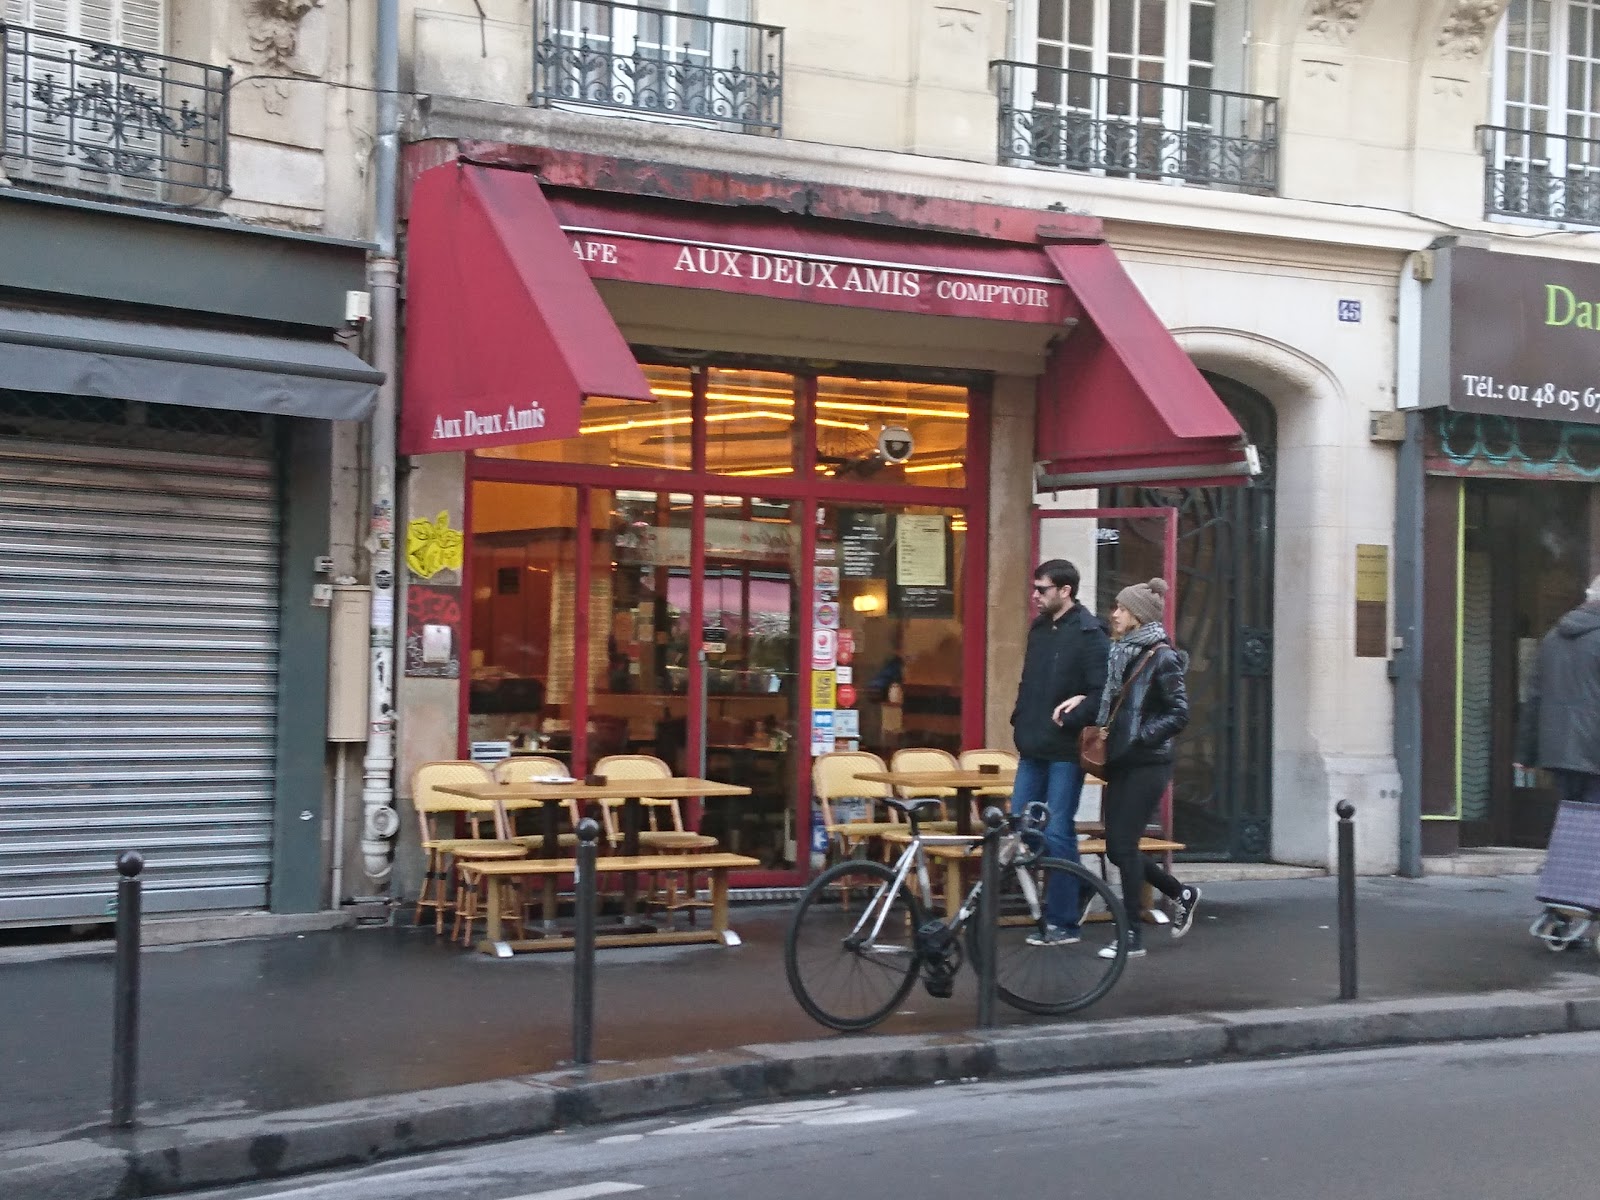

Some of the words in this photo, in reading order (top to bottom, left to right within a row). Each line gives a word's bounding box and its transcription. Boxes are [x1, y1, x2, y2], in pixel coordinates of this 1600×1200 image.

[673, 245, 743, 278] AUX
[749, 254, 838, 289] DEUX
[842, 266, 920, 298] AMIS
[936, 280, 1049, 308] COMPTOIR
[1340, 302, 1360, 320] 45
[1461, 374, 1504, 399] Tél.:
[1507, 384, 1529, 402] 01
[1531, 382, 1555, 408] 48
[1559, 389, 1580, 412] 05
[431, 413, 462, 439] Aux
[464, 410, 502, 436] Deux
[503, 400, 545, 431] Amis
